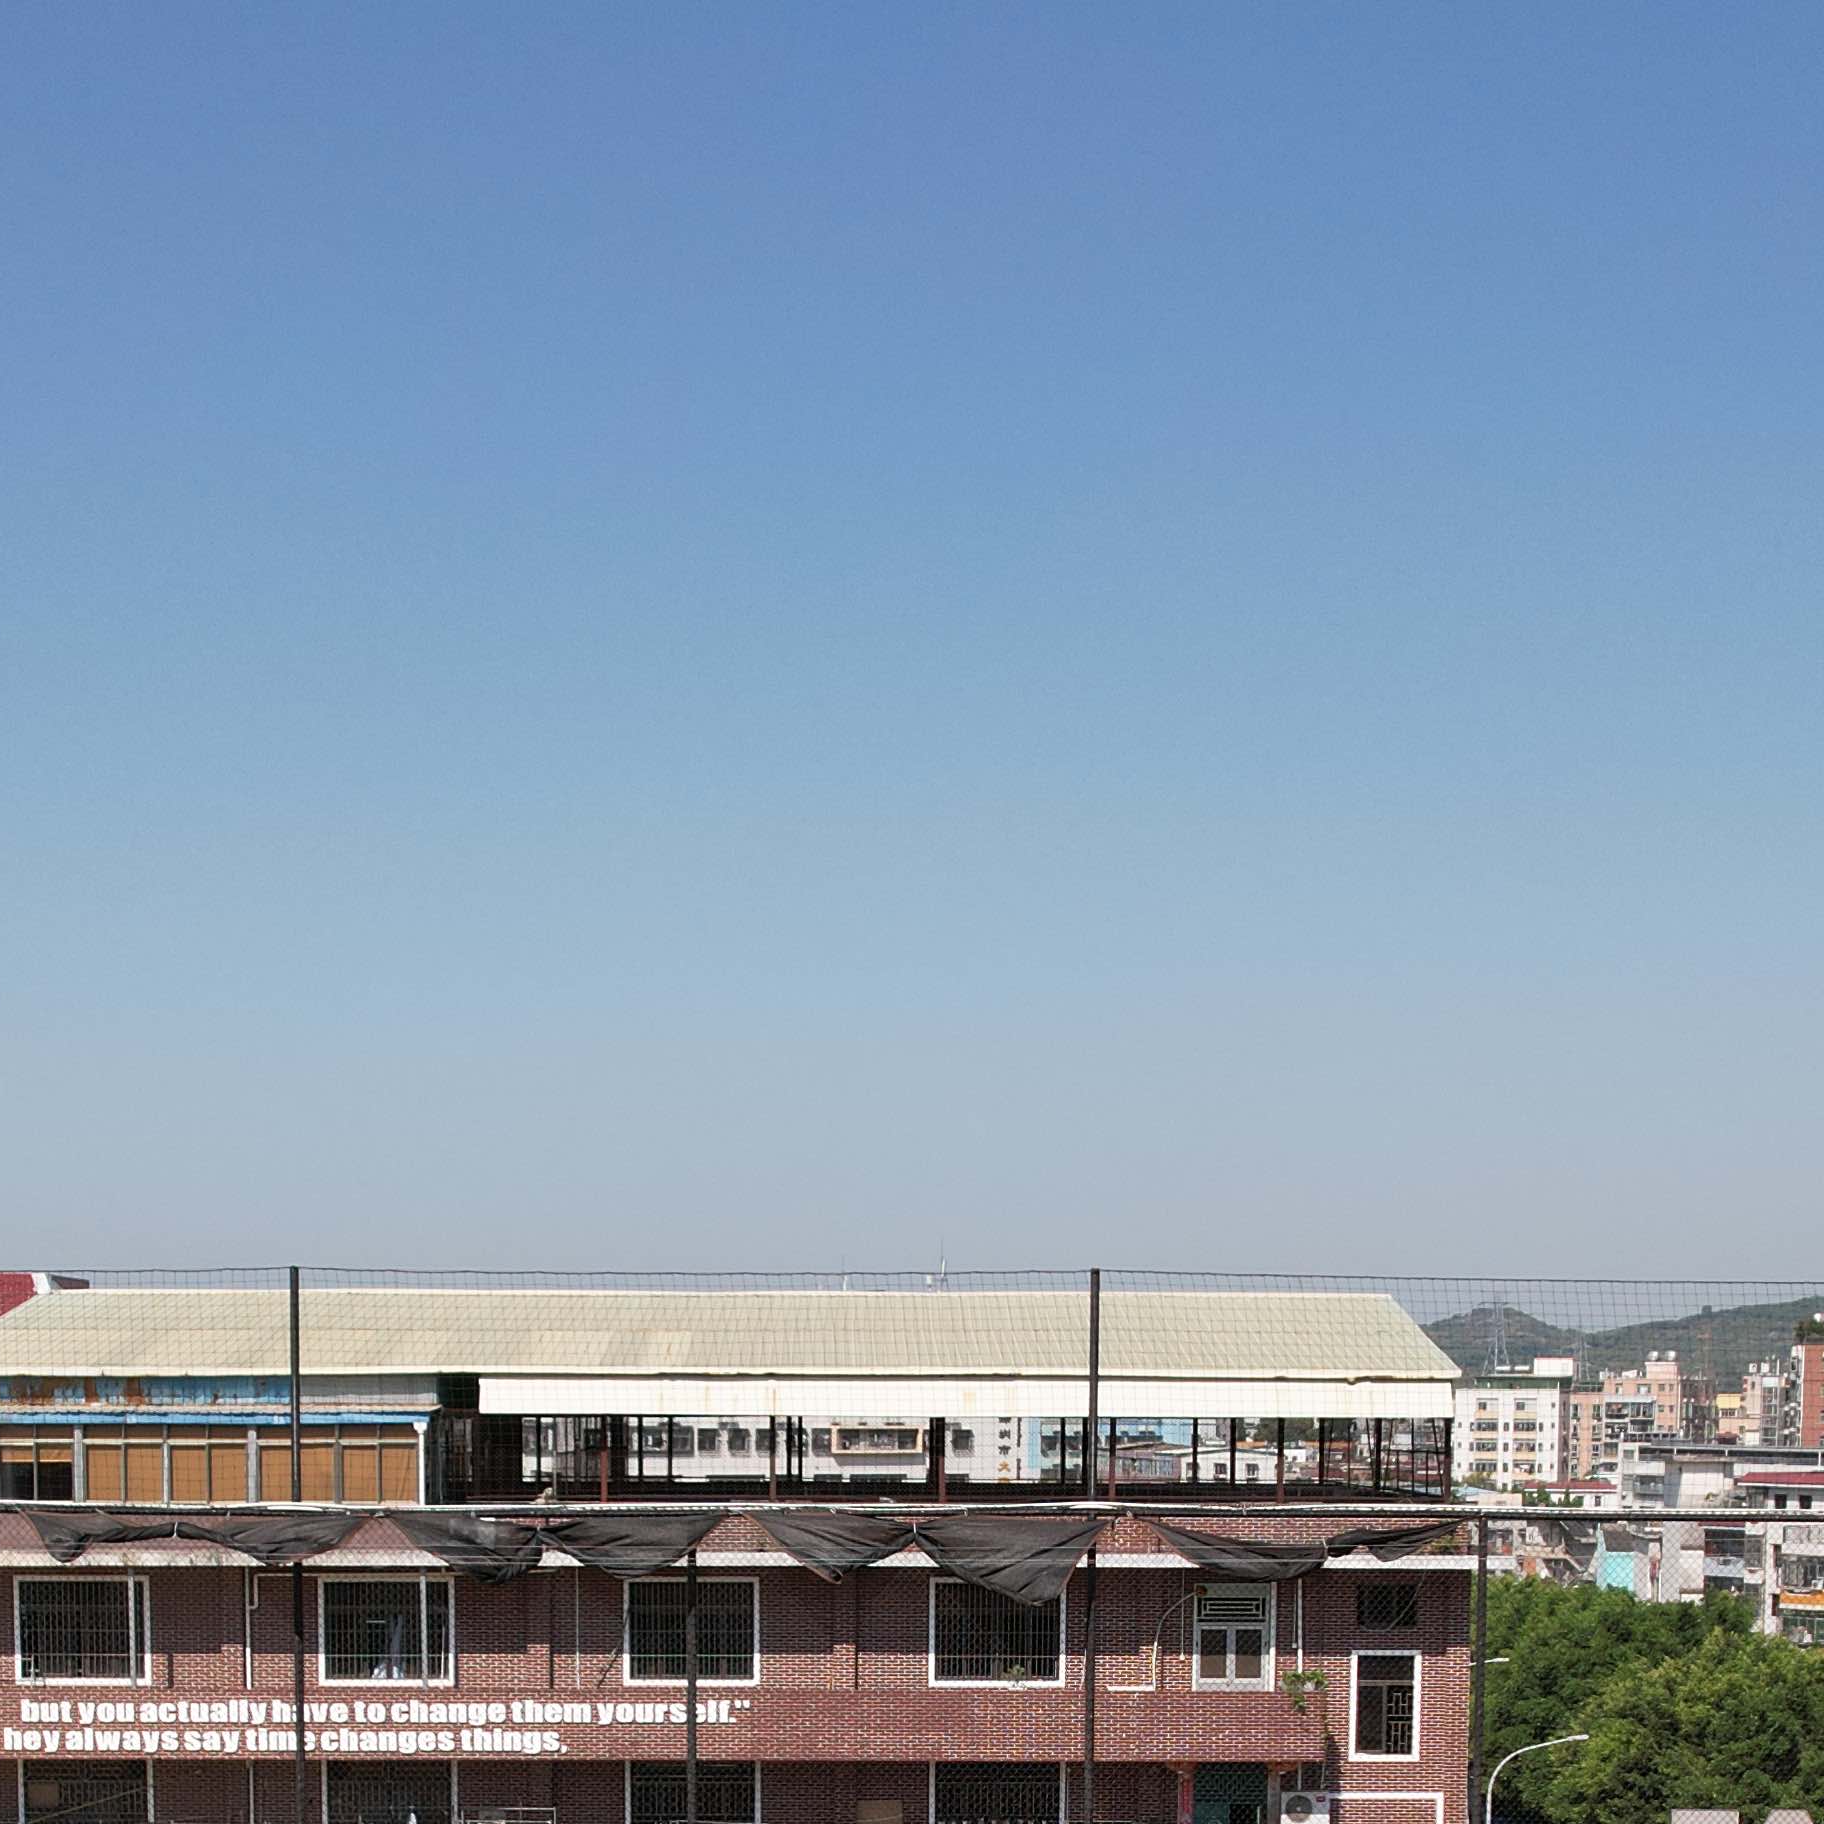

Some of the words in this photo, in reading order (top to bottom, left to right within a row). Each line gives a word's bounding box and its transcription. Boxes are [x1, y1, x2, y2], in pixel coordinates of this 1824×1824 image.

[20, 1699, 72, 1723] but
[78, 1700, 137, 1725] you
[138, 1699, 267, 1725] actually
[271, 1699, 349, 1723] have
[354, 1701, 385, 1723] to
[390, 1701, 509, 1725] change
[511, 1701, 594, 1723] them
[3, 1728, 60, 1753] hey
[64, 1728, 181, 1752] always
[182, 1730, 242, 1753] say
[245, 1728, 316, 1752] time
[320, 1728, 455, 1754] changes
[460, 1728, 569, 1754] things,
